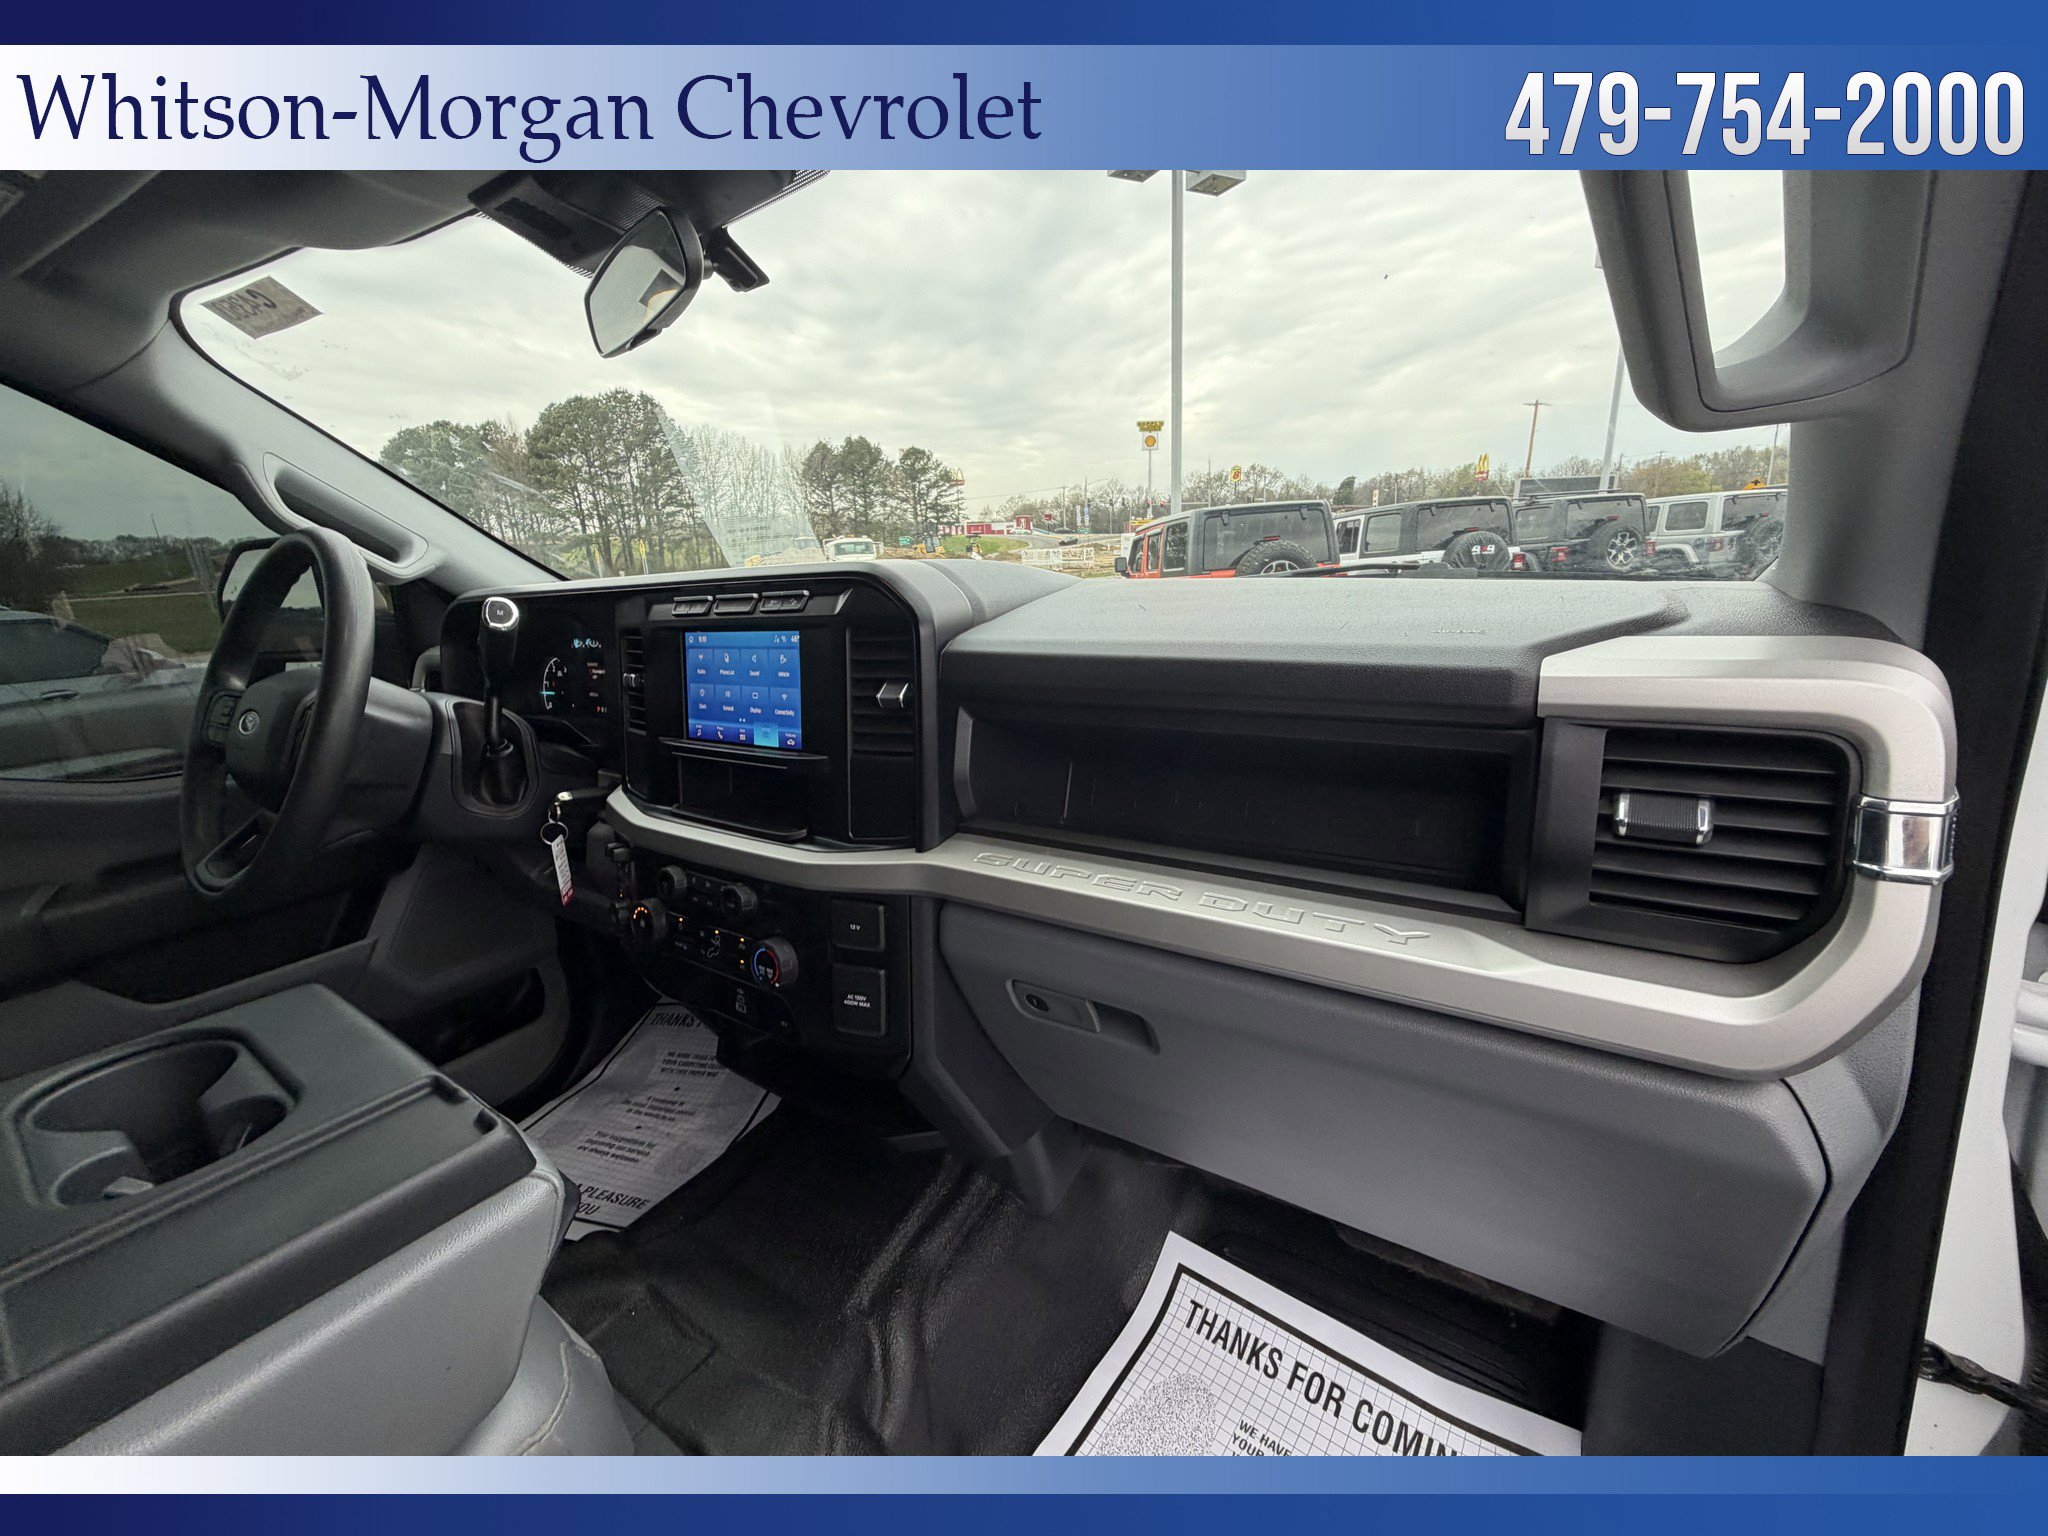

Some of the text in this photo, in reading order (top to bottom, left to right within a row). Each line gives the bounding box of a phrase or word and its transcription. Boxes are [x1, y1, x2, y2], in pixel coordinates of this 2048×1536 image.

[974, 852, 1430, 947] SUPER DUTY
[652, 1012, 695, 1028] THANKS
[577, 1202, 601, 1215] OU
[580, 1185, 650, 1210] PLEASURE
[1185, 1299, 1282, 1380] THANKS
[1286, 1360, 1346, 1419] FOR
[1239, 1419, 1259, 1440] WE
